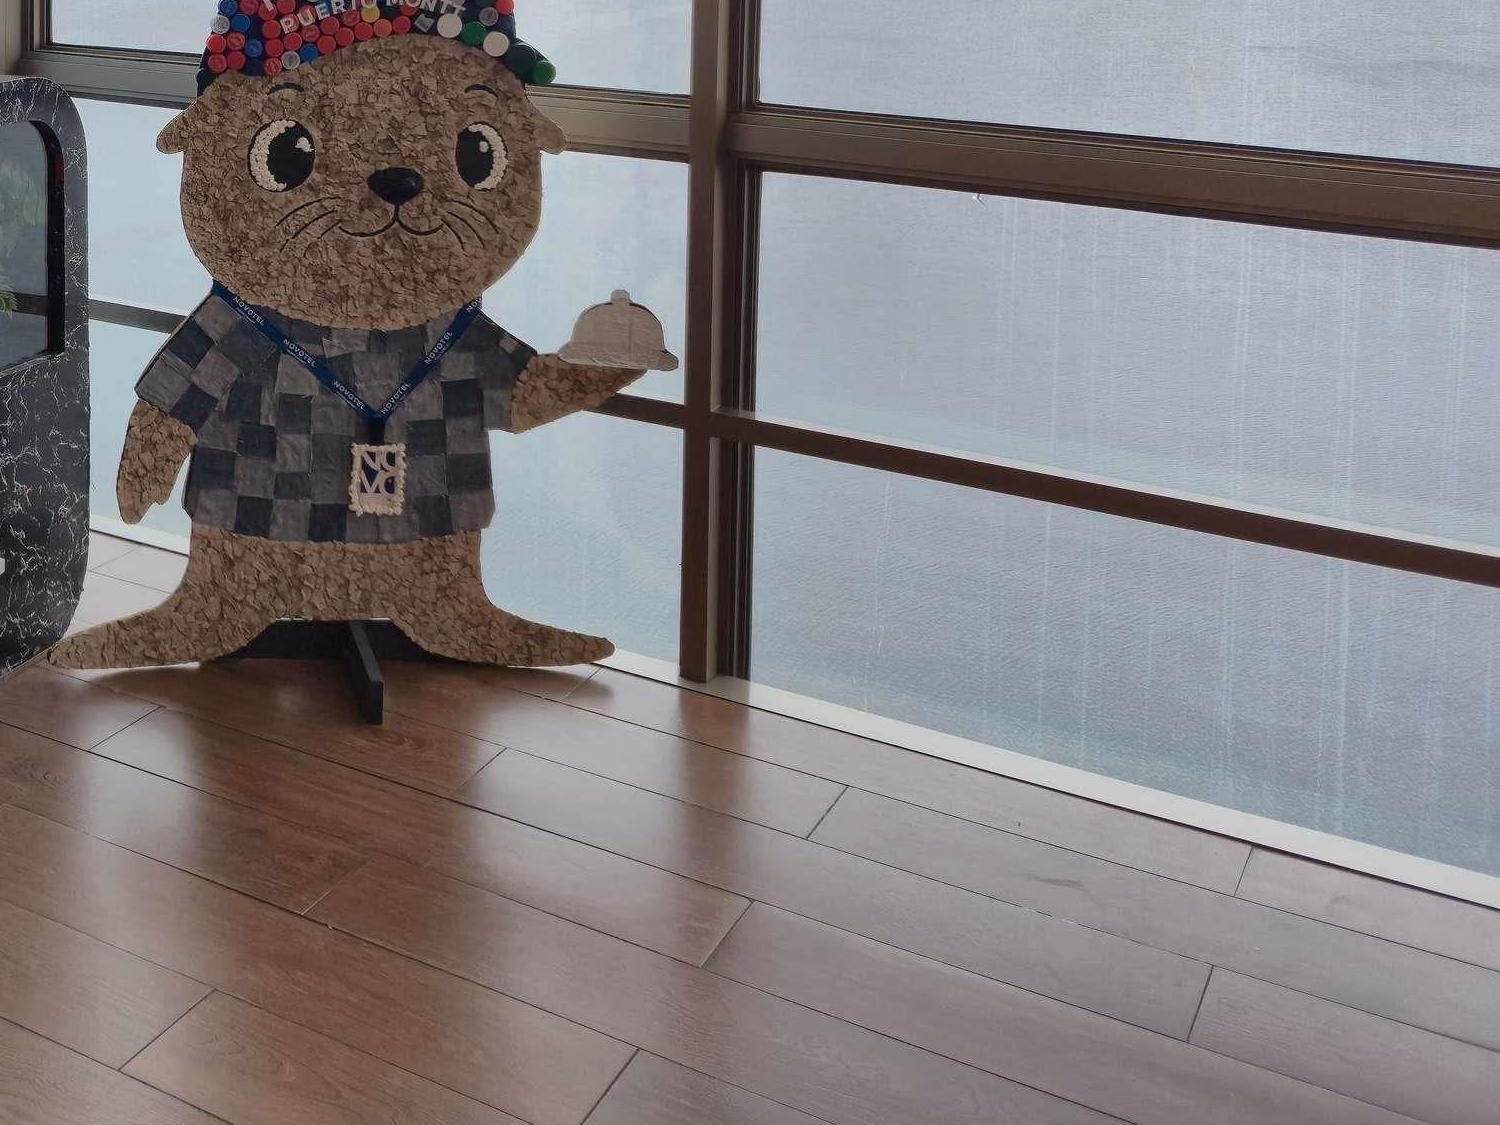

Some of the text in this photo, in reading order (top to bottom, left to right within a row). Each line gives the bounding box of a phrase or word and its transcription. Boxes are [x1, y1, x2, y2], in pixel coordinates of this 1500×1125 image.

[233, 296, 265, 326] NOVOTEL
[283, 338, 317, 367] NOVOTEL
[424, 330, 454, 365] NOVOTEL
[333, 380, 366, 411] NOVOTEL
[380, 382, 412, 416] NOVOTEL
